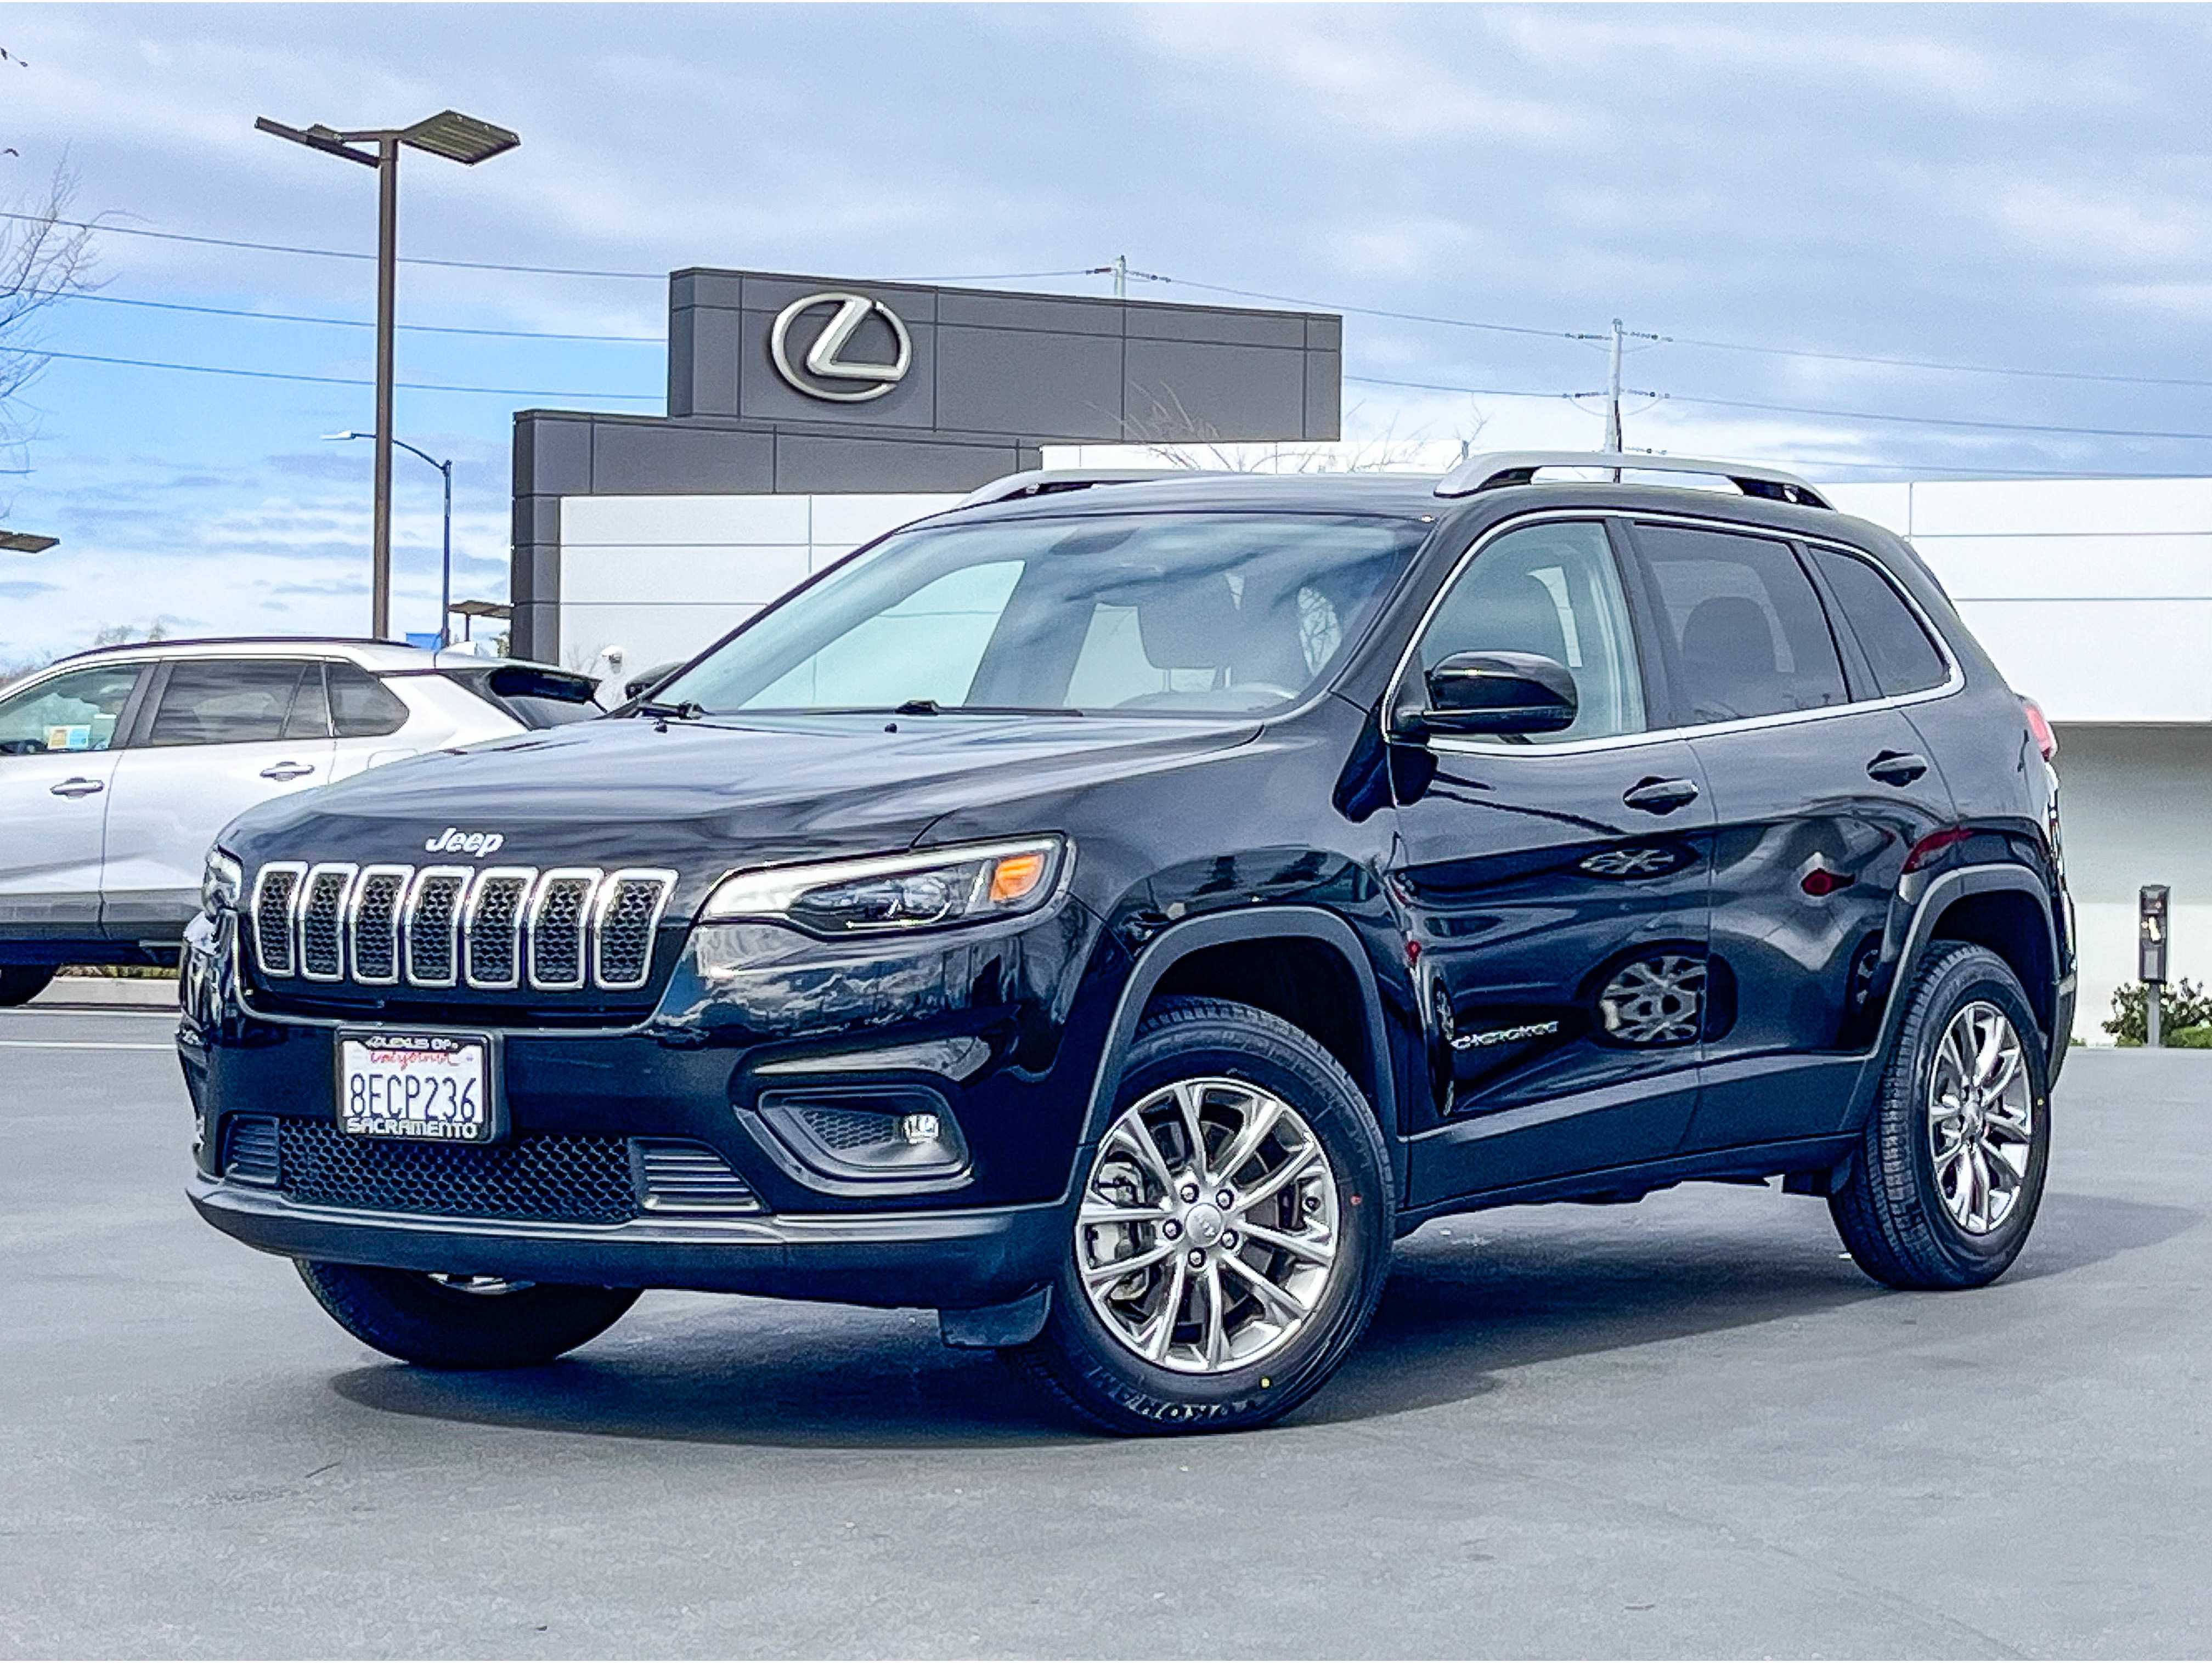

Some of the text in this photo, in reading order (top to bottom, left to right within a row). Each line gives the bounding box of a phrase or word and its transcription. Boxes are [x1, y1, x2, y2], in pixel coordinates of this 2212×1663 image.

[425, 827, 504, 858] Jeep
[351, 1073, 476, 1122] 8ECP236
[347, 1117, 477, 1139] SACRAMENTO
